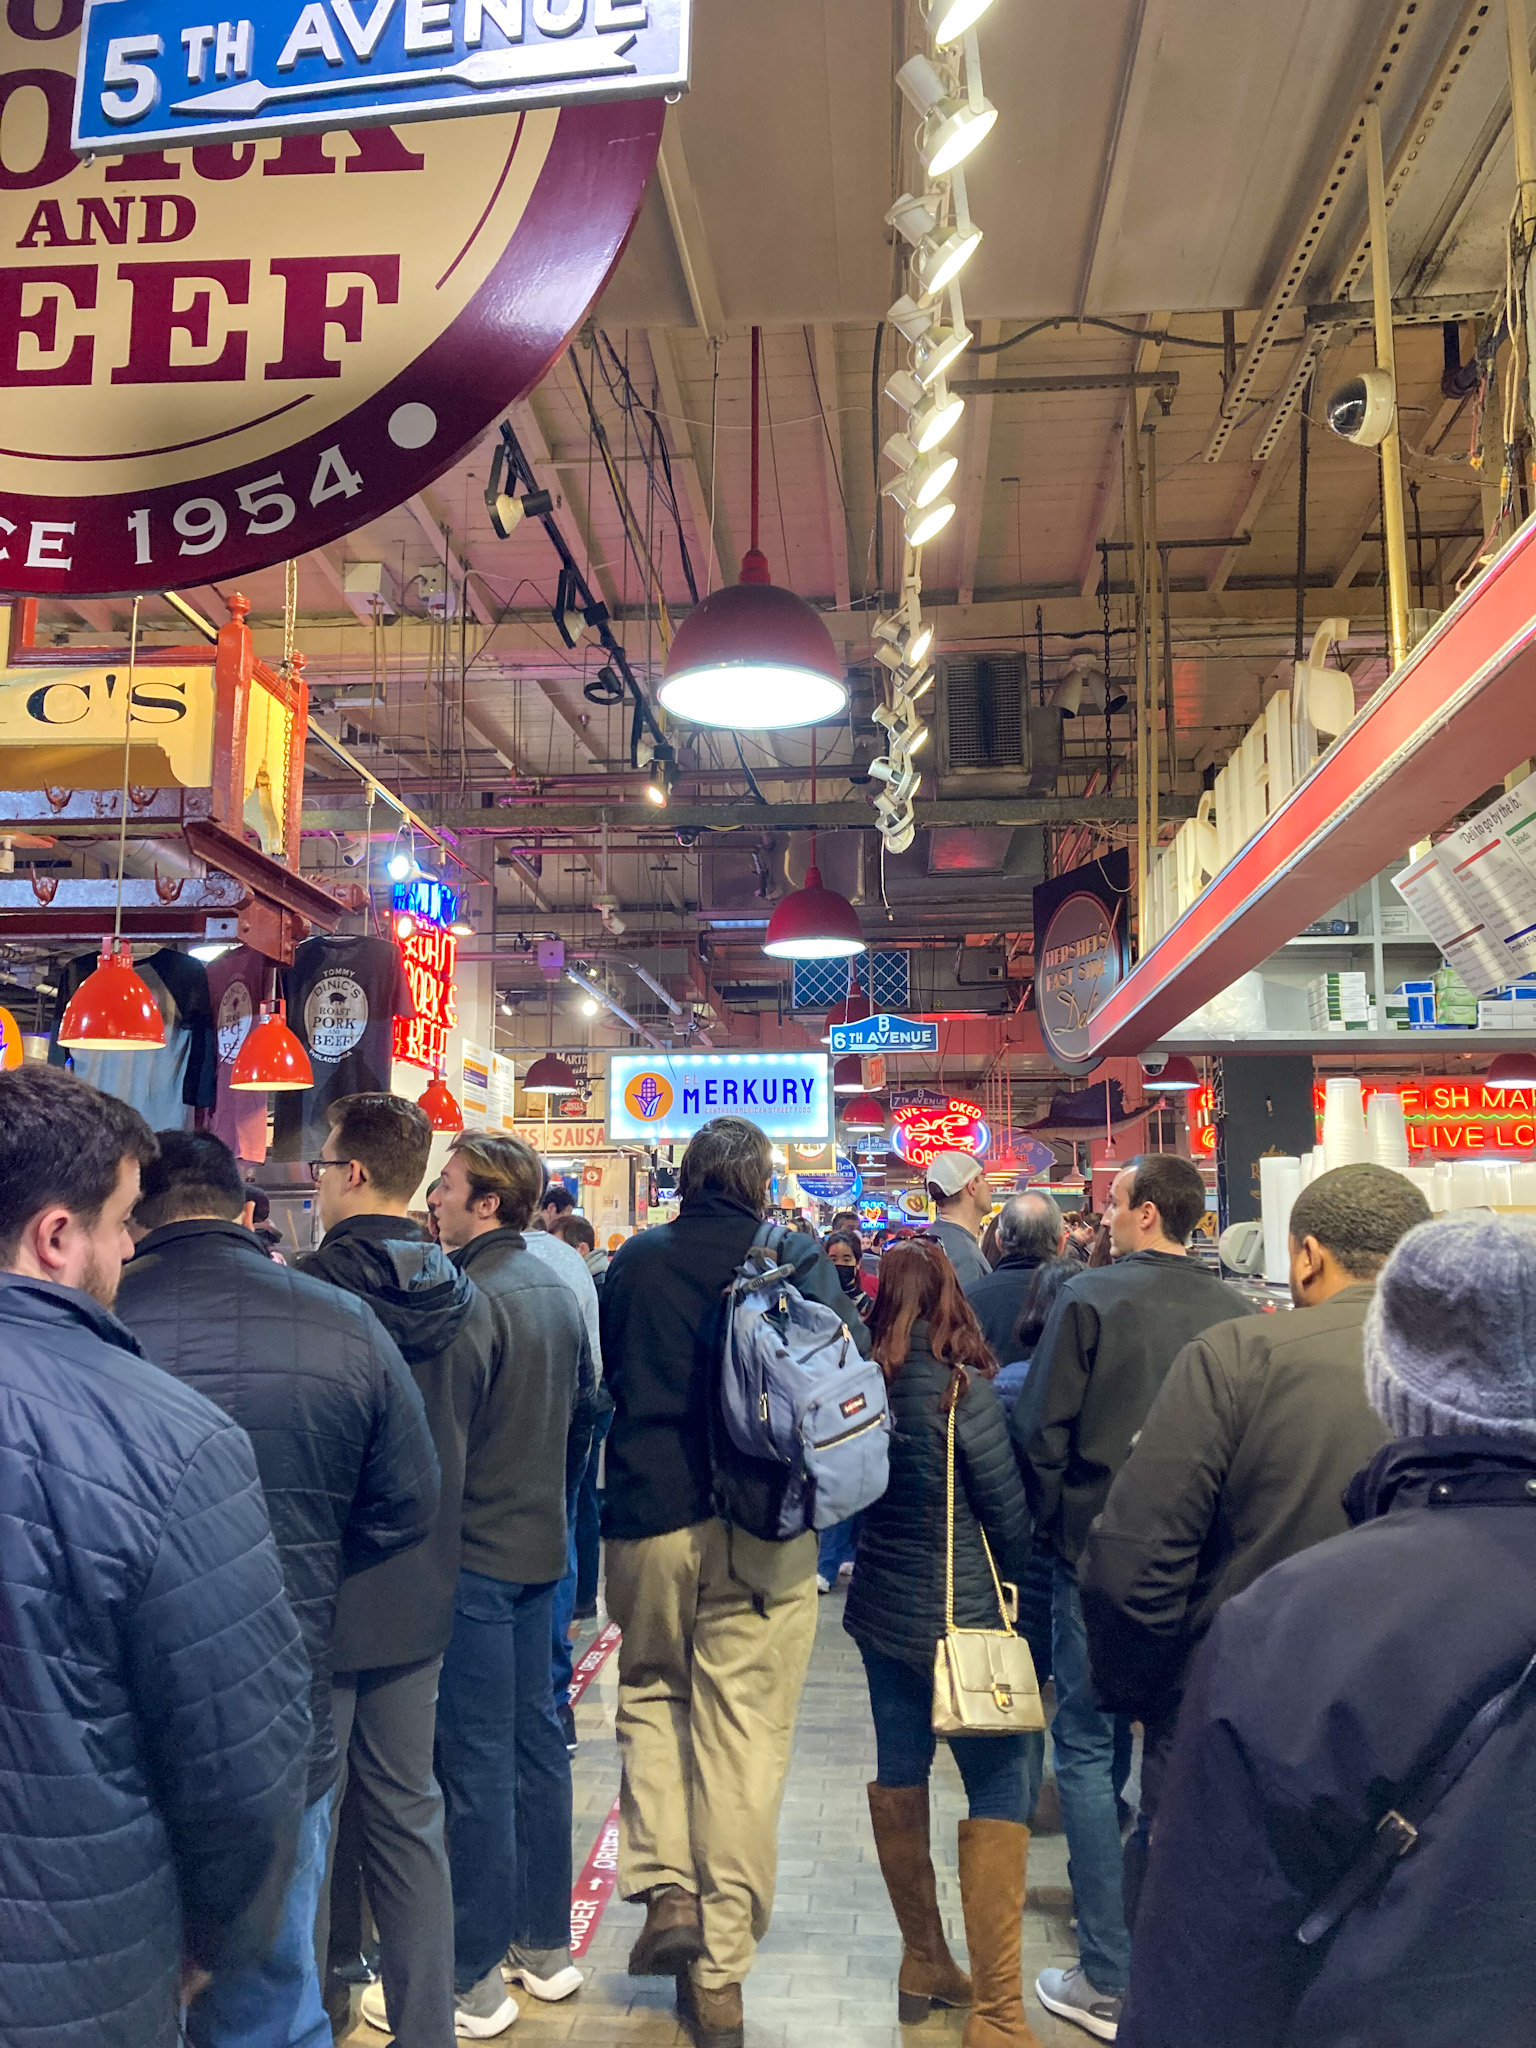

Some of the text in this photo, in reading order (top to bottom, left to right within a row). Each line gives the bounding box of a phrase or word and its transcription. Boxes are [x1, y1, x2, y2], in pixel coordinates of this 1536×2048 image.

[15, 194, 197, 248] AND
[127, 444, 364, 565] 1954
[1474, 824, 1486, 836] to
[1482, 818, 1494, 834] go
[1488, 811, 1503, 826] by
[1498, 803, 1513, 818] the
[1512, 831, 1531, 846] Salads
[322, 967, 356, 979] TOMMY
[1045, 965, 1075, 993] EAST
[319, 1007, 352, 1016] ROAST
[312, 1016, 357, 1030] PORK
[879, 1016, 890, 1032] B
[312, 1034, 353, 1047] BEEF
[867, 1030, 932, 1044] AVENUE
[869, 1058, 884, 1084] EXIT
[684, 1074, 699, 1085] EL
[683, 1078, 815, 1114] MERKURY
[911, 1097, 947, 1105] AVENUE
[917, 1089, 924, 1098] B
[893, 1107, 921, 1123] LIVE
[949, 1100, 982, 1120] OKED
[1410, 1125, 1484, 1148] LIVE
[836, 1162, 853, 1171] Best
